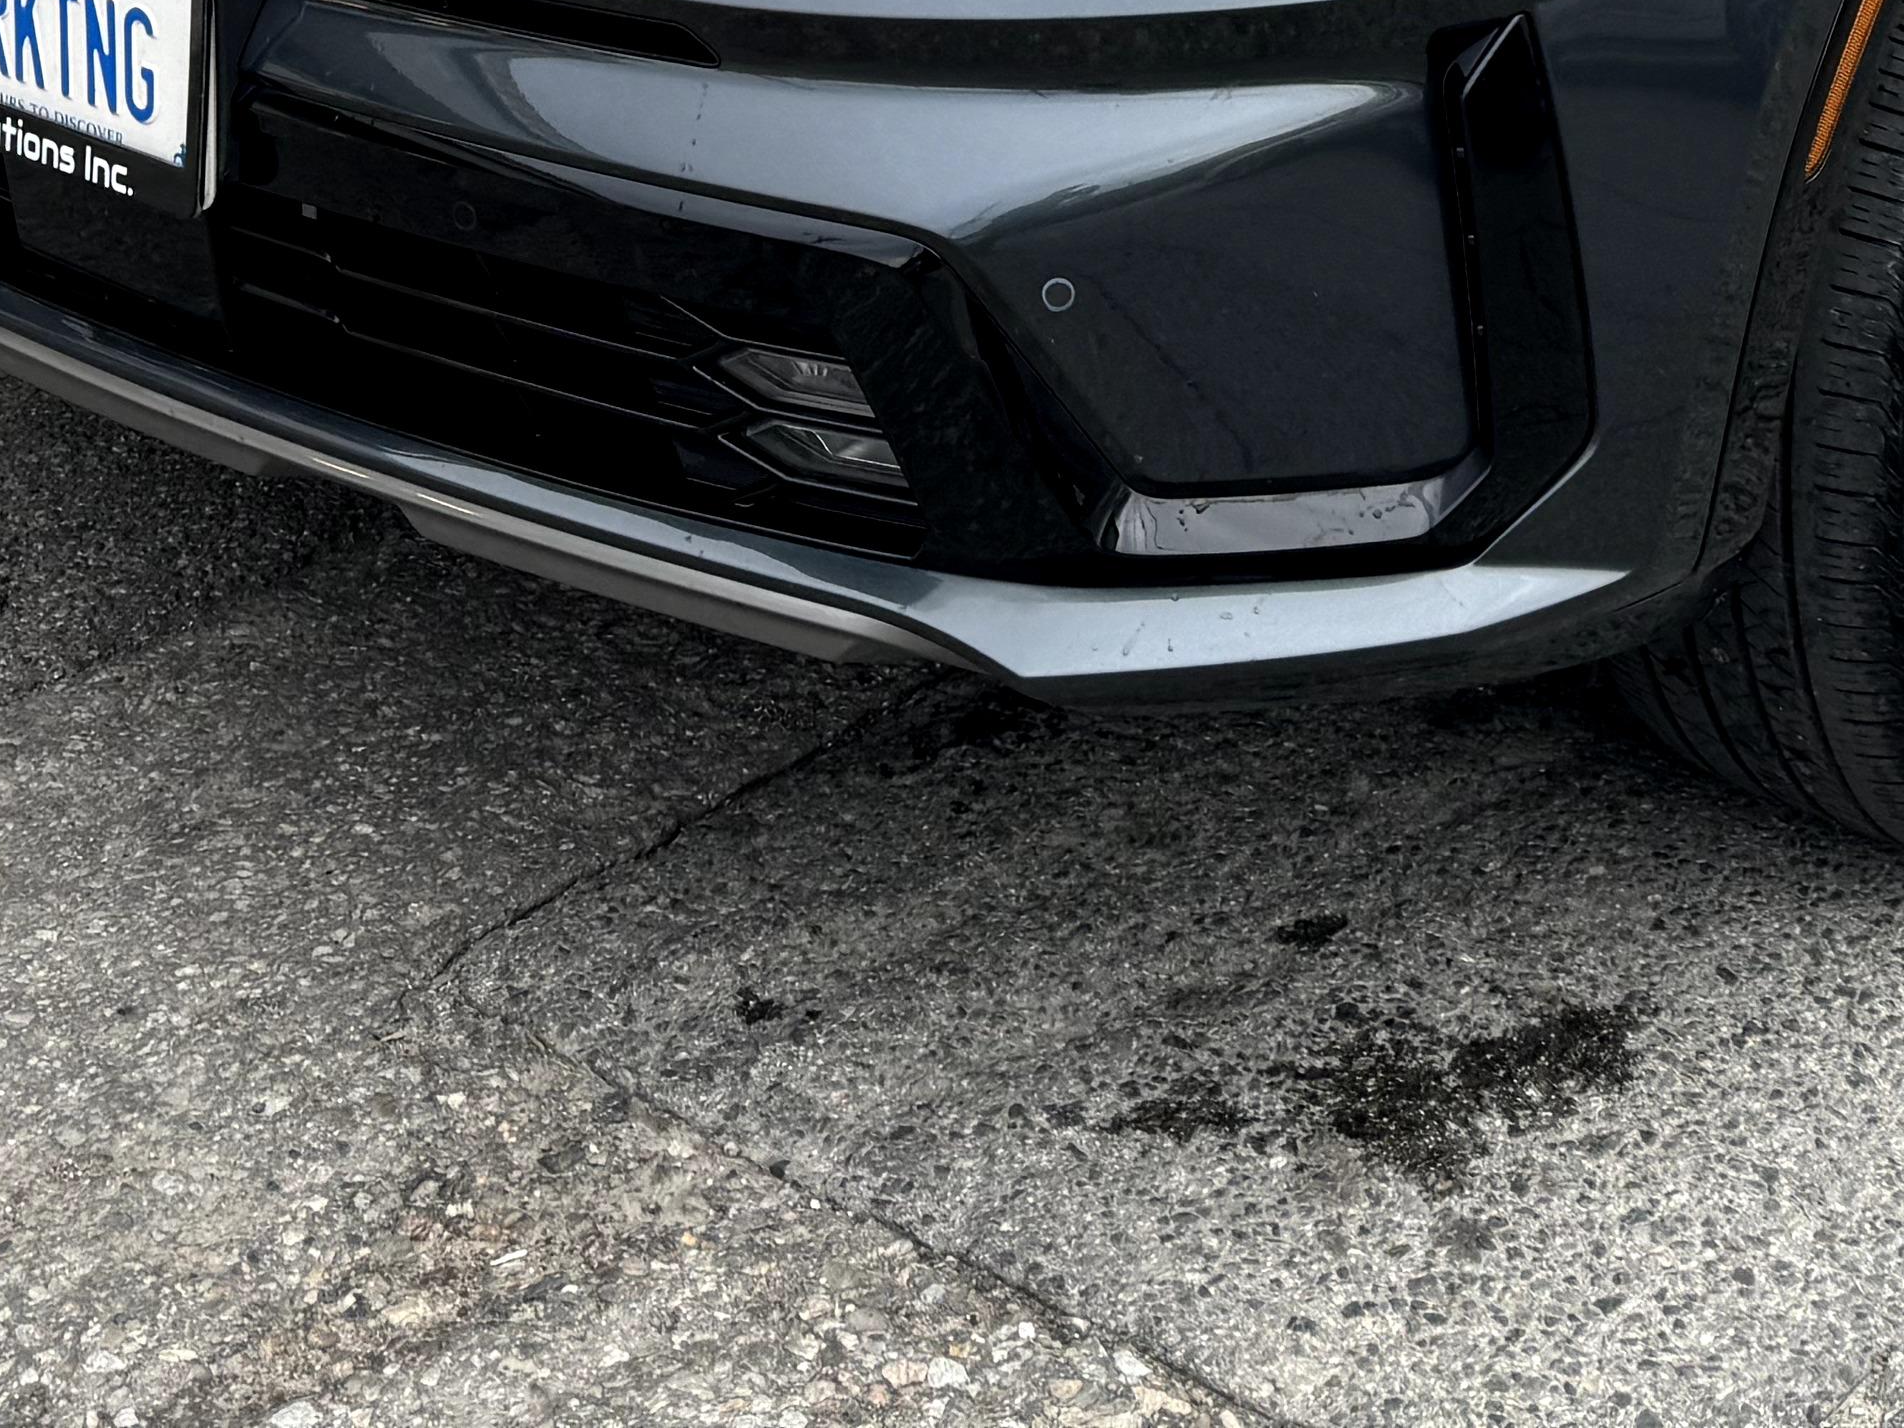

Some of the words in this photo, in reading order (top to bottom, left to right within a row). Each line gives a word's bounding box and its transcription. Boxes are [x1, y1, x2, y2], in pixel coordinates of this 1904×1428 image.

[29, 103, 49, 119] TO
[50, 111, 124, 144] DISCOVER
[84, 145, 134, 196] Inc.
